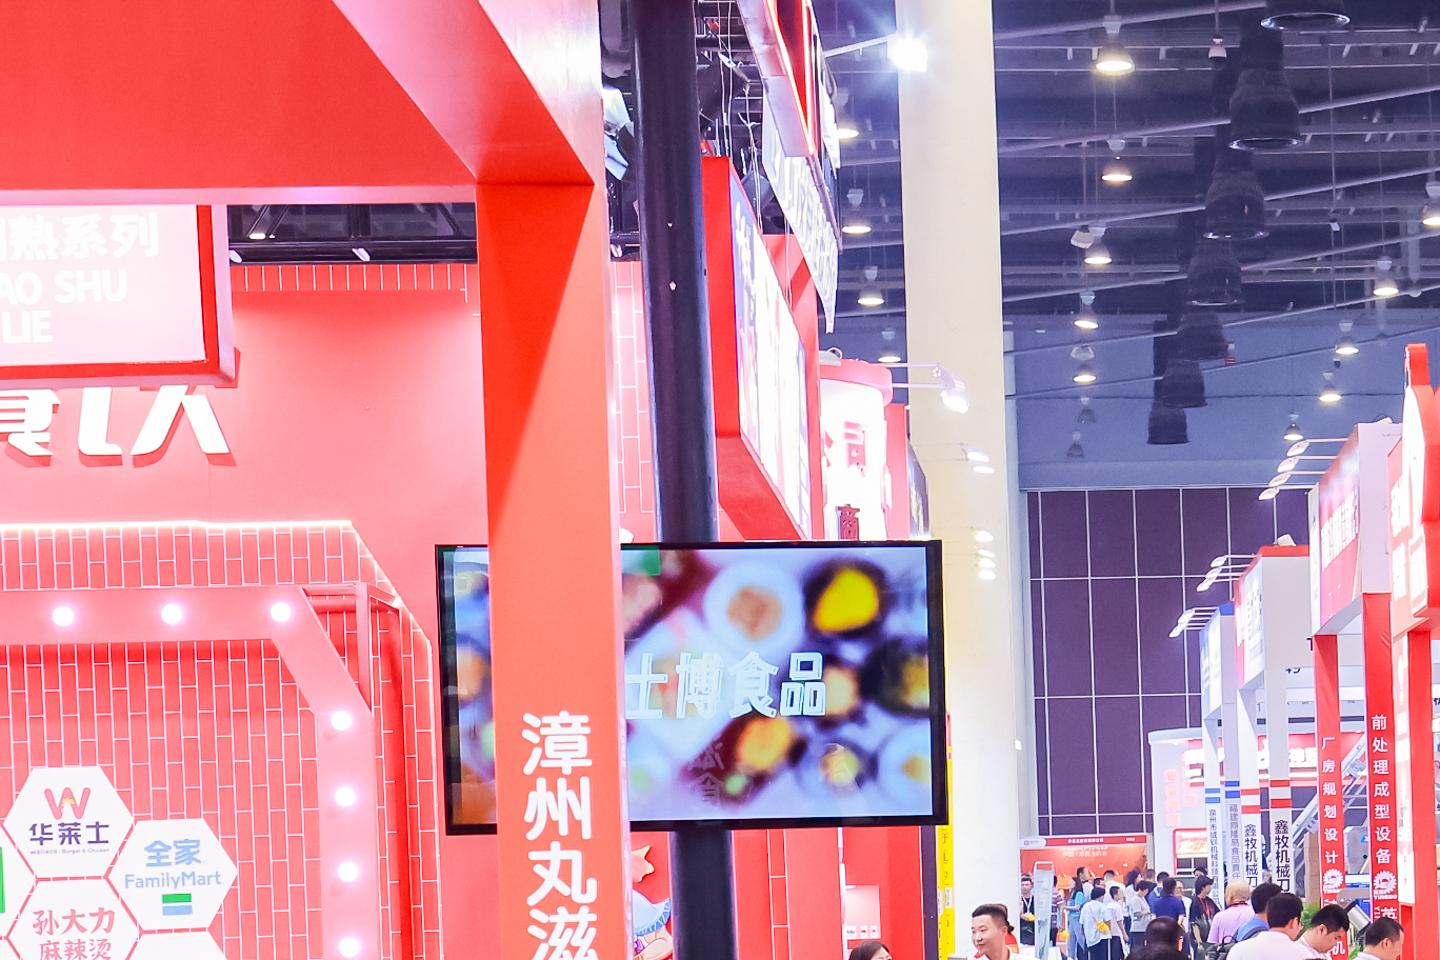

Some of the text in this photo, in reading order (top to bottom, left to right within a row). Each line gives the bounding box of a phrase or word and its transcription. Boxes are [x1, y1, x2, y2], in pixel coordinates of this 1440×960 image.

[0, 268, 128, 305] AO SHU
[1321, 737, 1339, 864] 厂房规划设计
[1372, 715, 1392, 864] 前处理成型设备
[29, 821, 110, 846] 华莱士
[144, 839, 201, 867] 全家
[124, 871, 222, 890] FamilyMart
[32, 907, 116, 935] 孙大力
